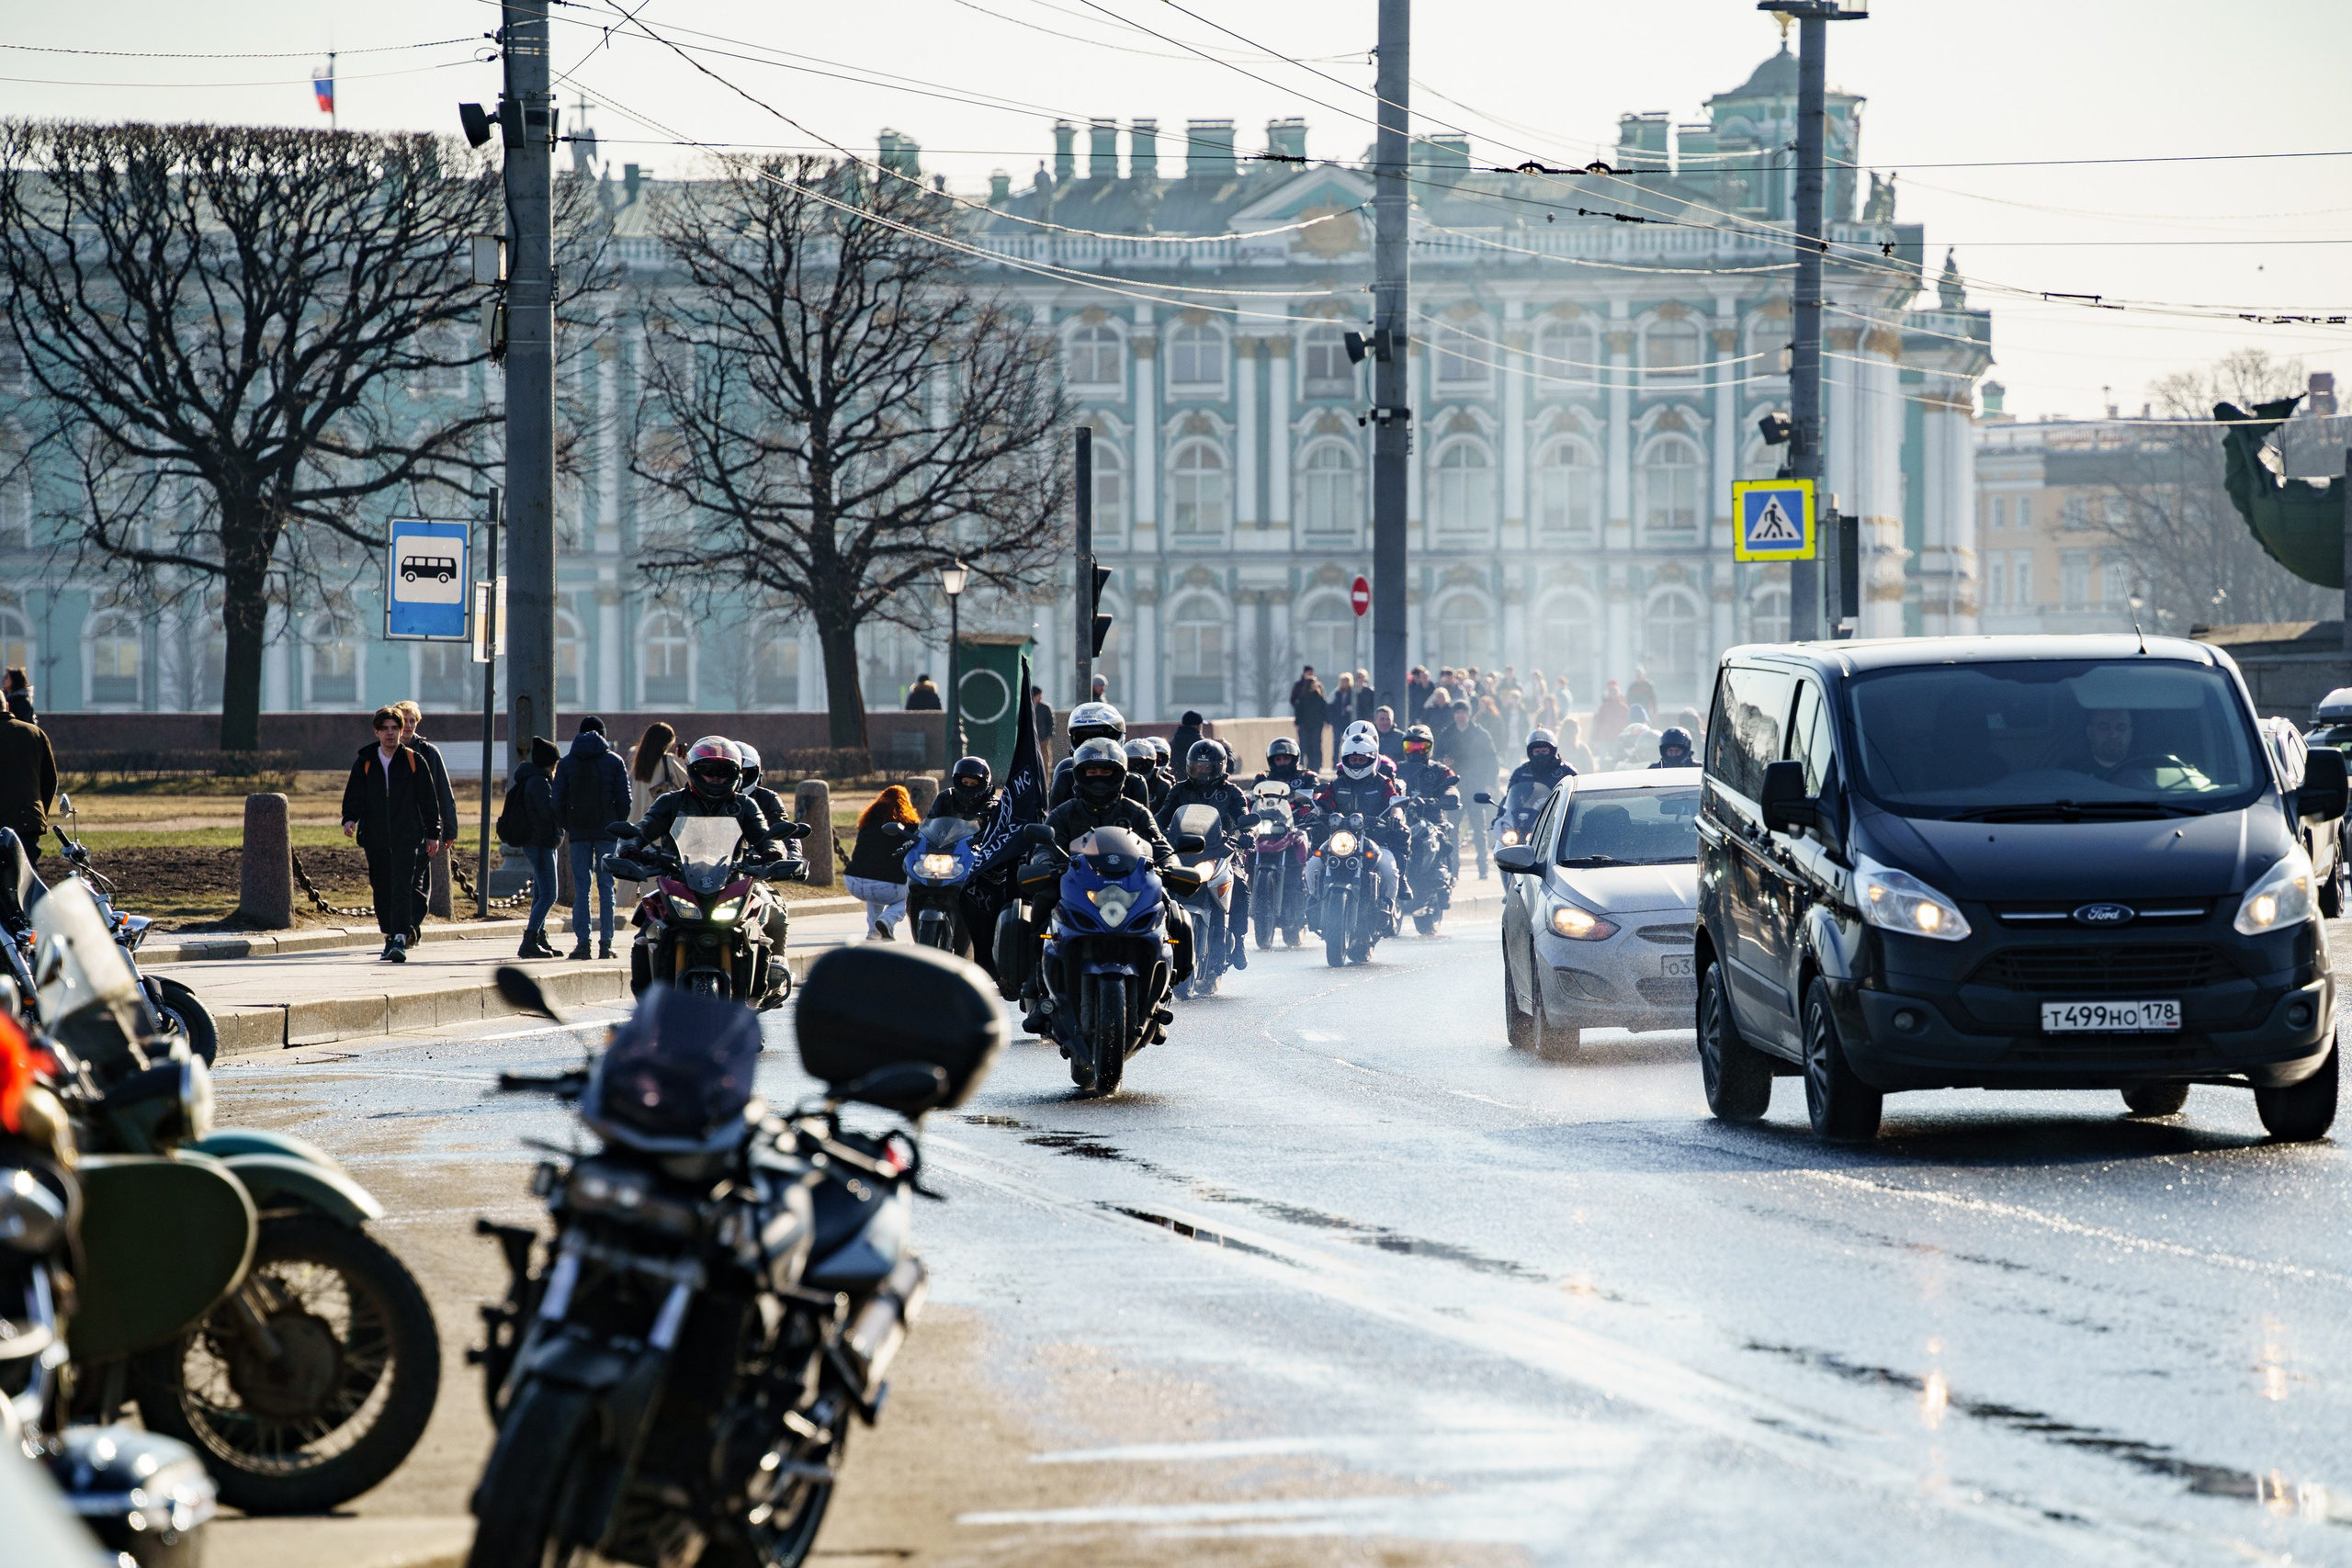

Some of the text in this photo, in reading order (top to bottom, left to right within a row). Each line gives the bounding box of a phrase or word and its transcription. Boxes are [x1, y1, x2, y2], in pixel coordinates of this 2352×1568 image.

[1013, 770, 1032, 795] MC
[2051, 1004, 2174, 1027] Т499НО 178
